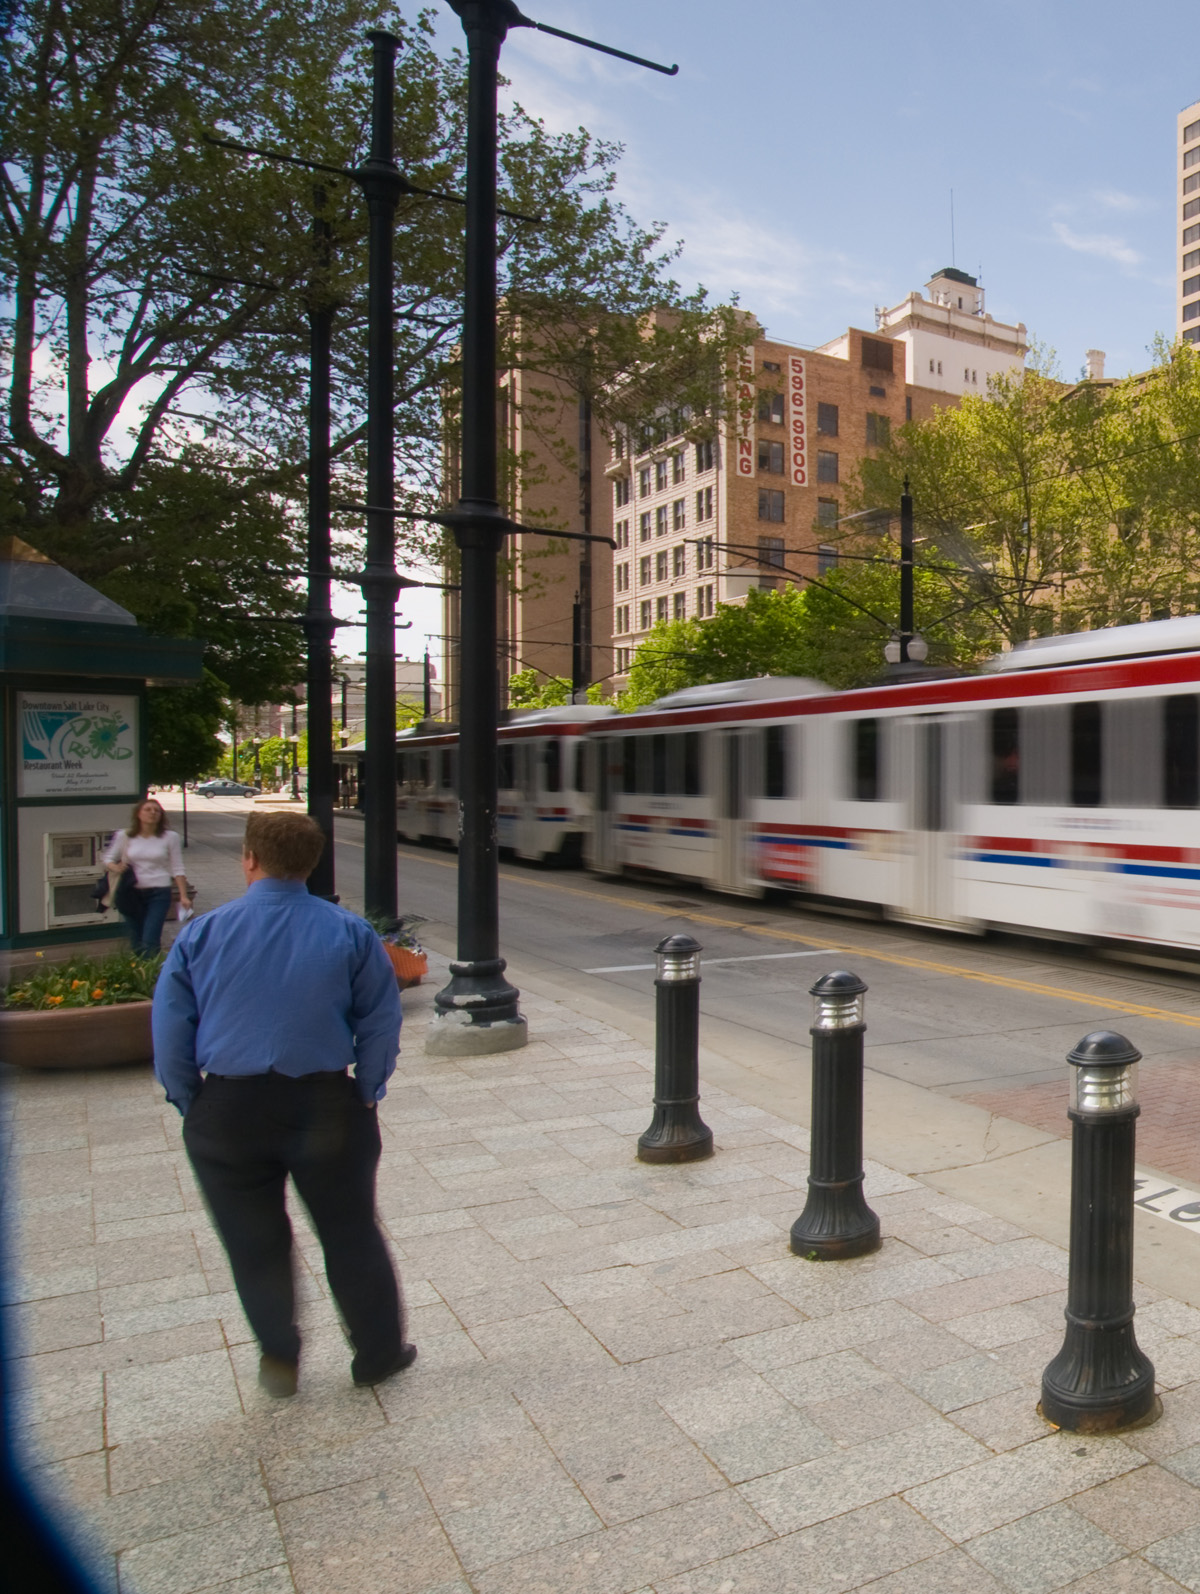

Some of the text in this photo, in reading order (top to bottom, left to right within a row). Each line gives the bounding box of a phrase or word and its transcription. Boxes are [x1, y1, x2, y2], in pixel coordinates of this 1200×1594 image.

[791, 358, 806, 485] 596-9900
[22, 701, 109, 712] Downtown Salt Lake City
[24, 760, 82, 770] Restaurant Week
